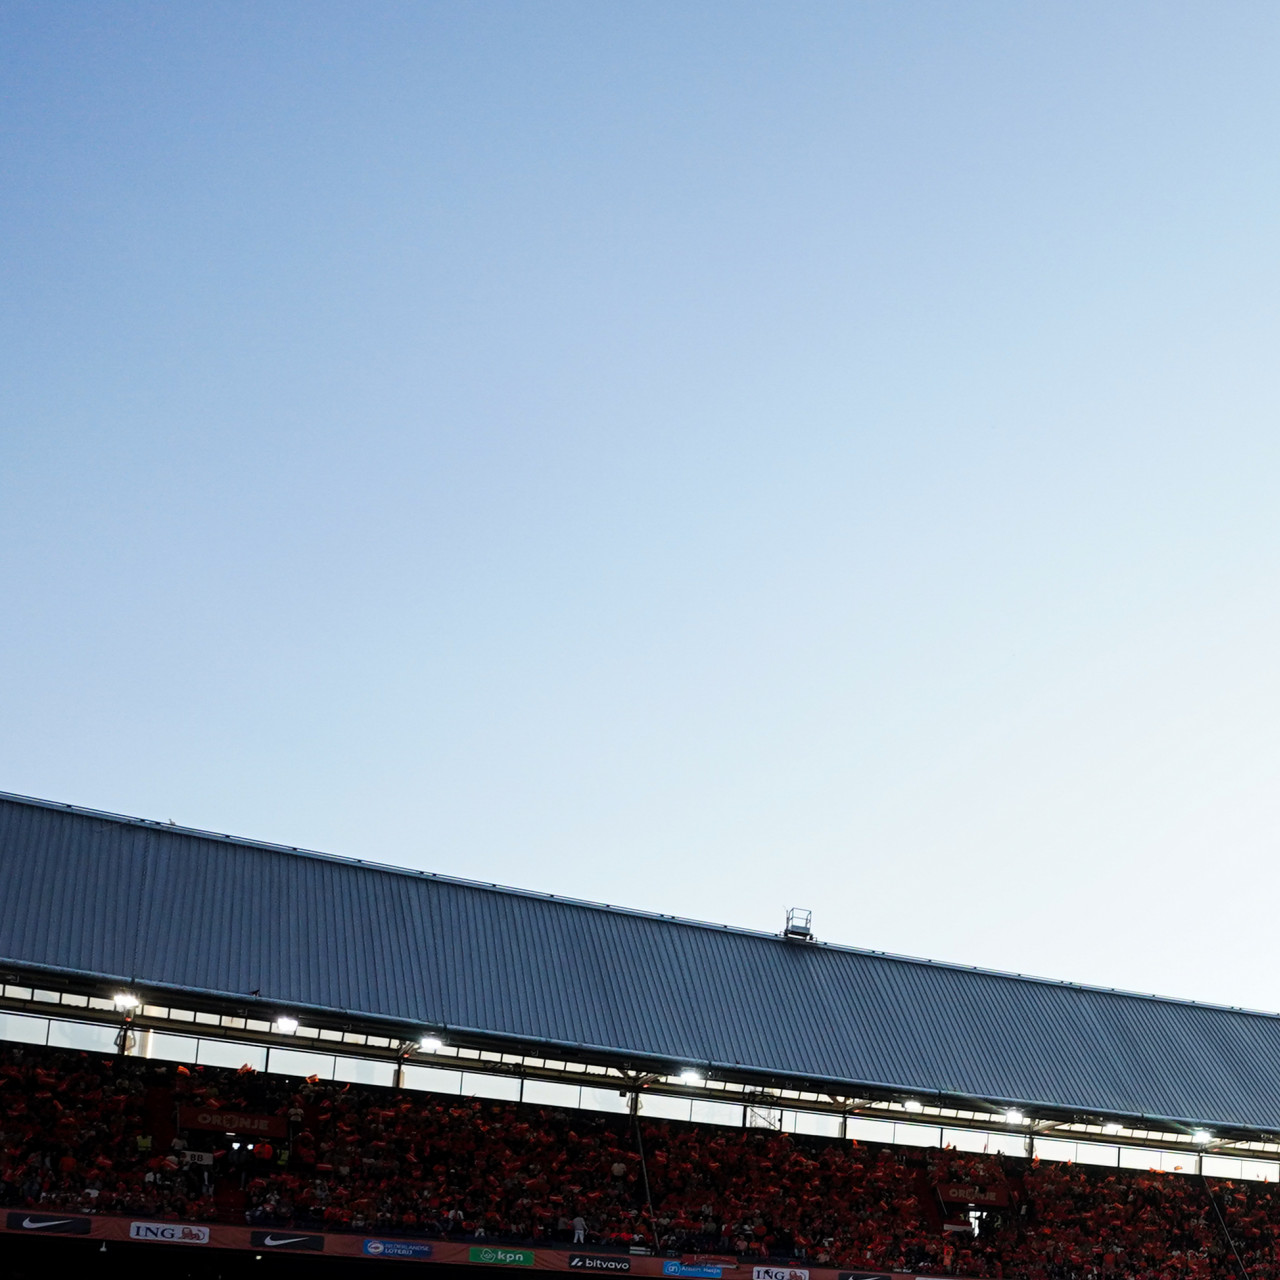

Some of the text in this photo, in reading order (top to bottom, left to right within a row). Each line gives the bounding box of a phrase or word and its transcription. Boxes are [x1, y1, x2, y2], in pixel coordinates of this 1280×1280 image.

[135, 1225, 175, 1239] ING
[498, 1251, 523, 1262] kpn
[586, 1258, 629, 1270] bitvavo
[756, 1270, 785, 1280] ING
